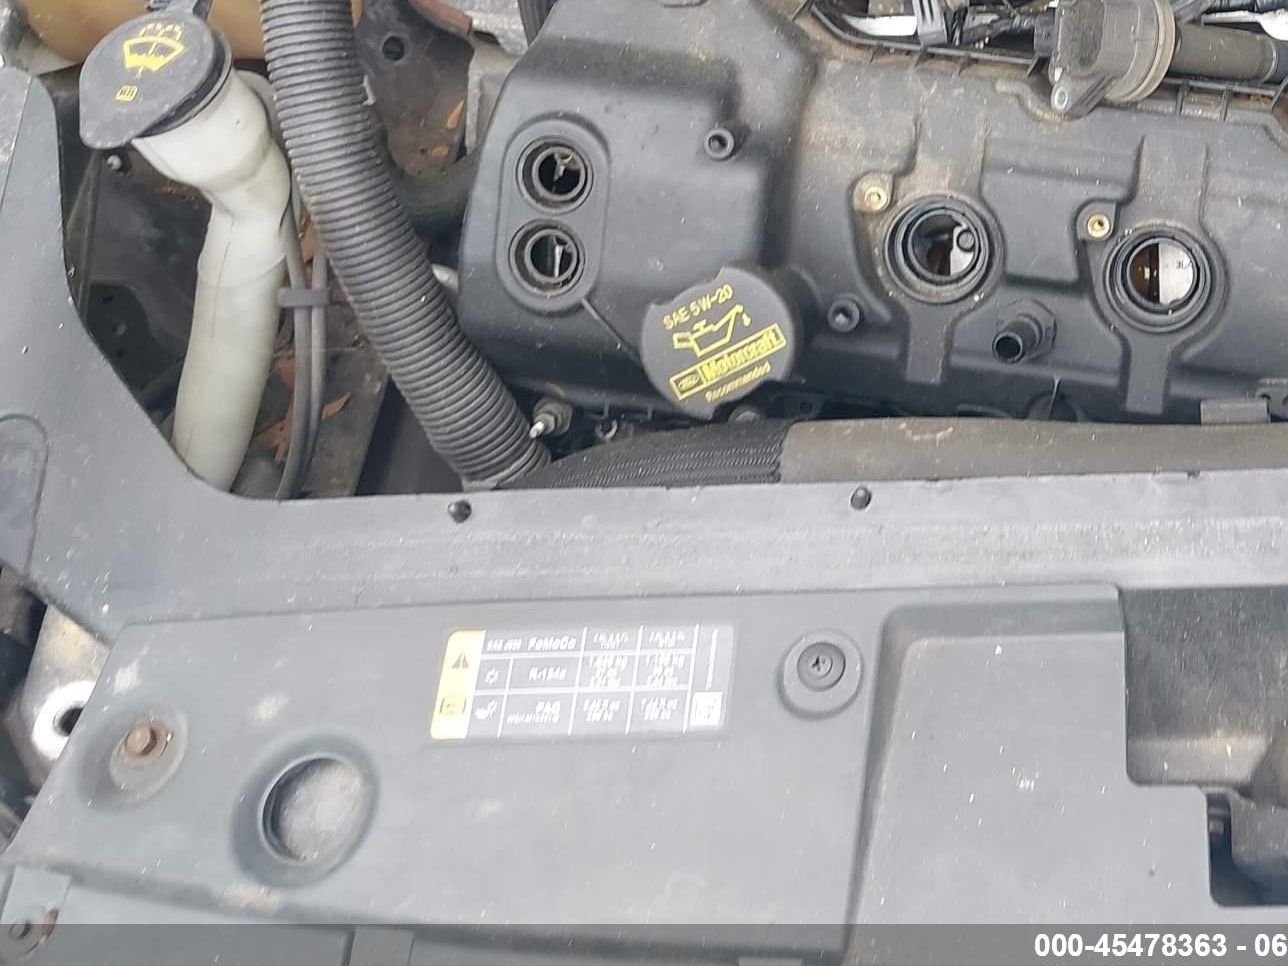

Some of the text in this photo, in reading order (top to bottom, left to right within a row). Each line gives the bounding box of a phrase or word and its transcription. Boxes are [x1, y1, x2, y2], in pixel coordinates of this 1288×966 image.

[663, 284, 734, 330] SAE 5W-20
[700, 328, 781, 382] Motorcraft
